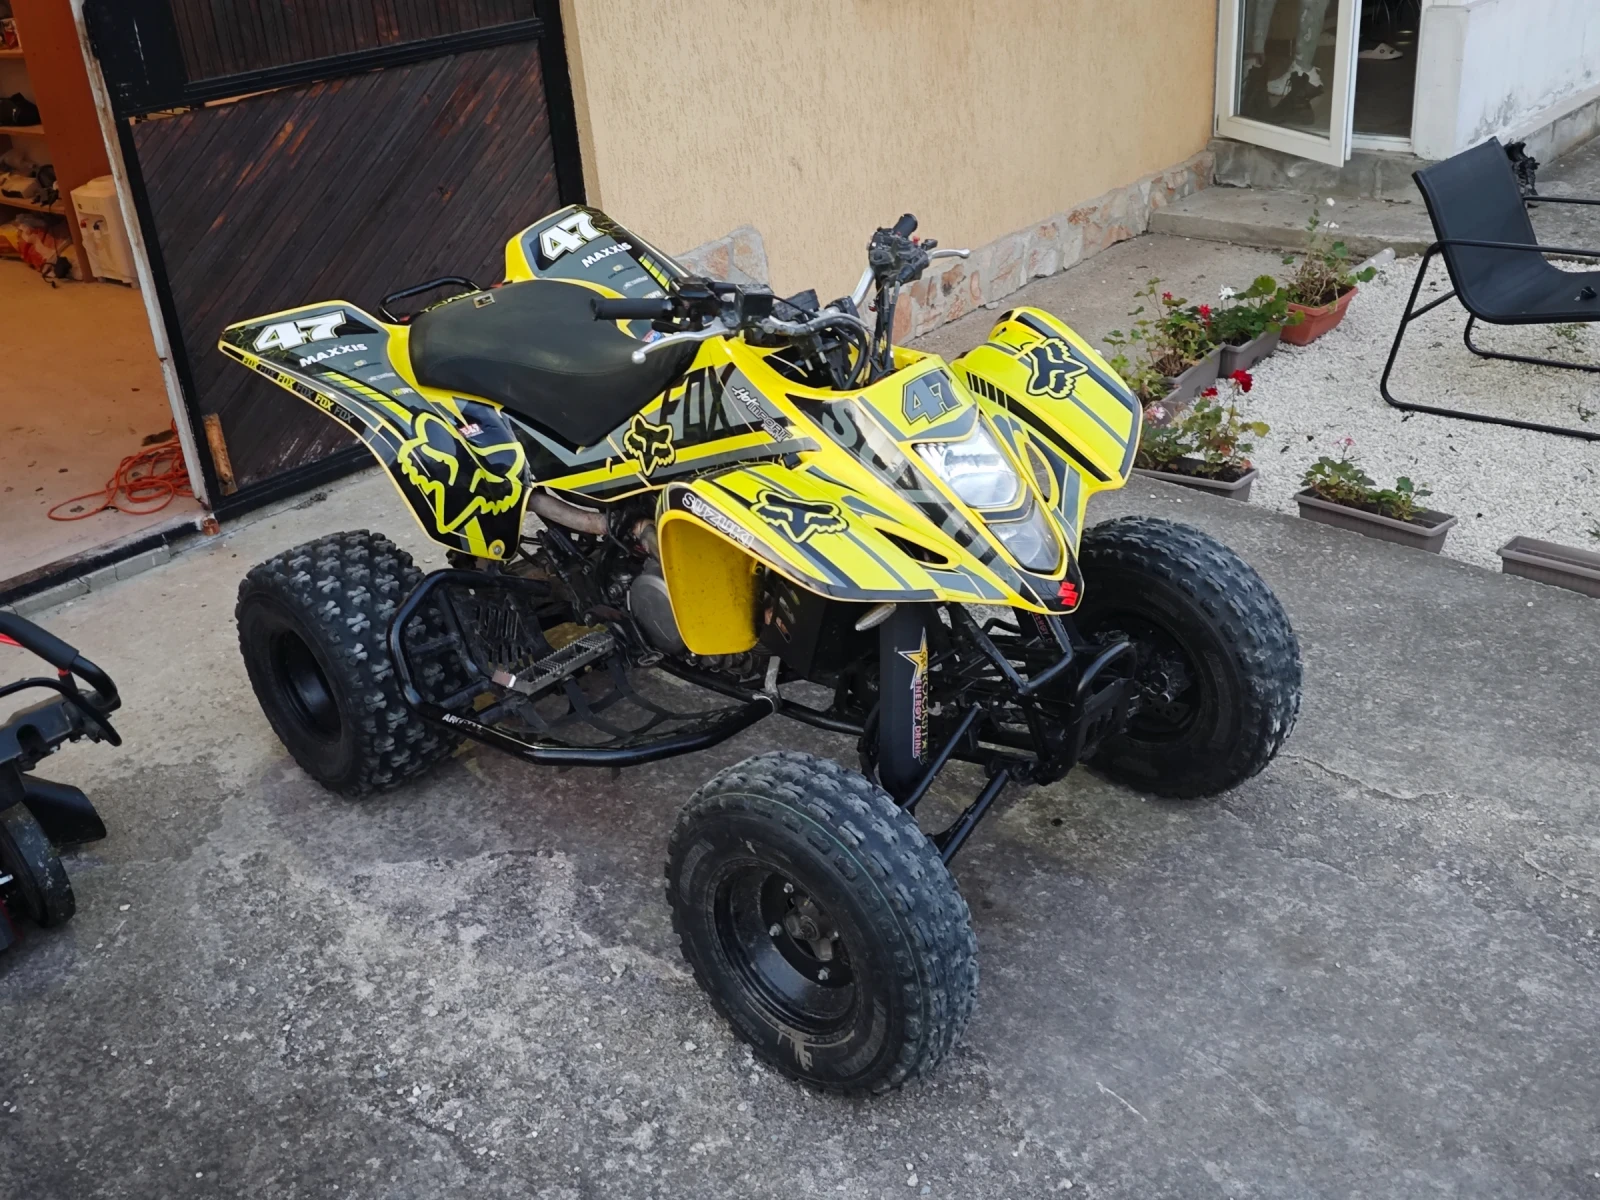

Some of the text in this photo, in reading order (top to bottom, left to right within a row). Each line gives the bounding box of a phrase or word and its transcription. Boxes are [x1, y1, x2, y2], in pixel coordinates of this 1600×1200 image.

[539, 210, 606, 261] 47
[581, 242, 632, 268] MAXXIS
[252, 309, 347, 352] 47
[299, 343, 368, 368] MAXXIS
[277, 373, 296, 390] FOX
[295, 383, 316, 399] FOX
[314, 392, 335, 412] FOX
[333, 405, 355, 424] FOX
[901, 367, 963, 426] 47
[681, 492, 755, 549] SUZUKI
[913, 678, 923, 758] ENERGY DRINK
